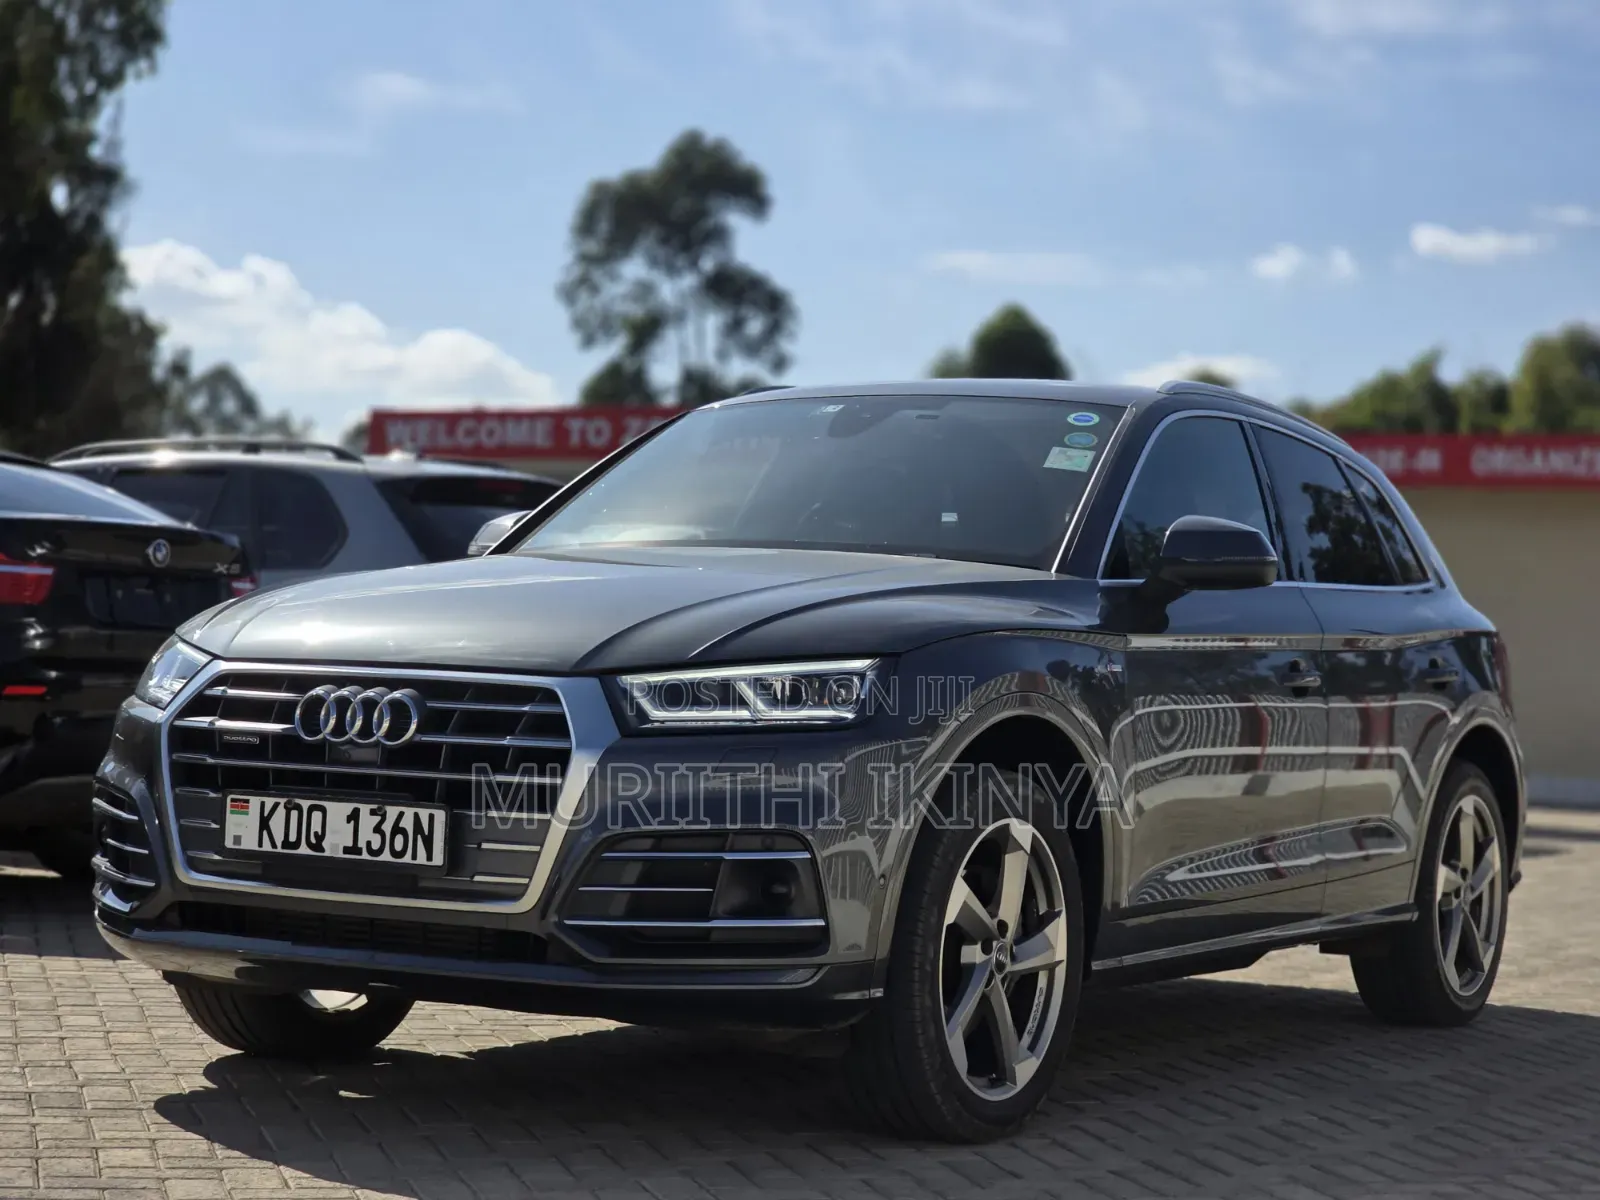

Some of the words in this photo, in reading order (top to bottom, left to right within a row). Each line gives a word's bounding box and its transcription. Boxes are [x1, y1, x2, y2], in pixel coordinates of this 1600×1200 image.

[386, 417, 553, 447] WELCOME
[563, 417, 611, 446] TO
[257, 800, 328, 853] KDQ
[342, 806, 435, 862] 136N
